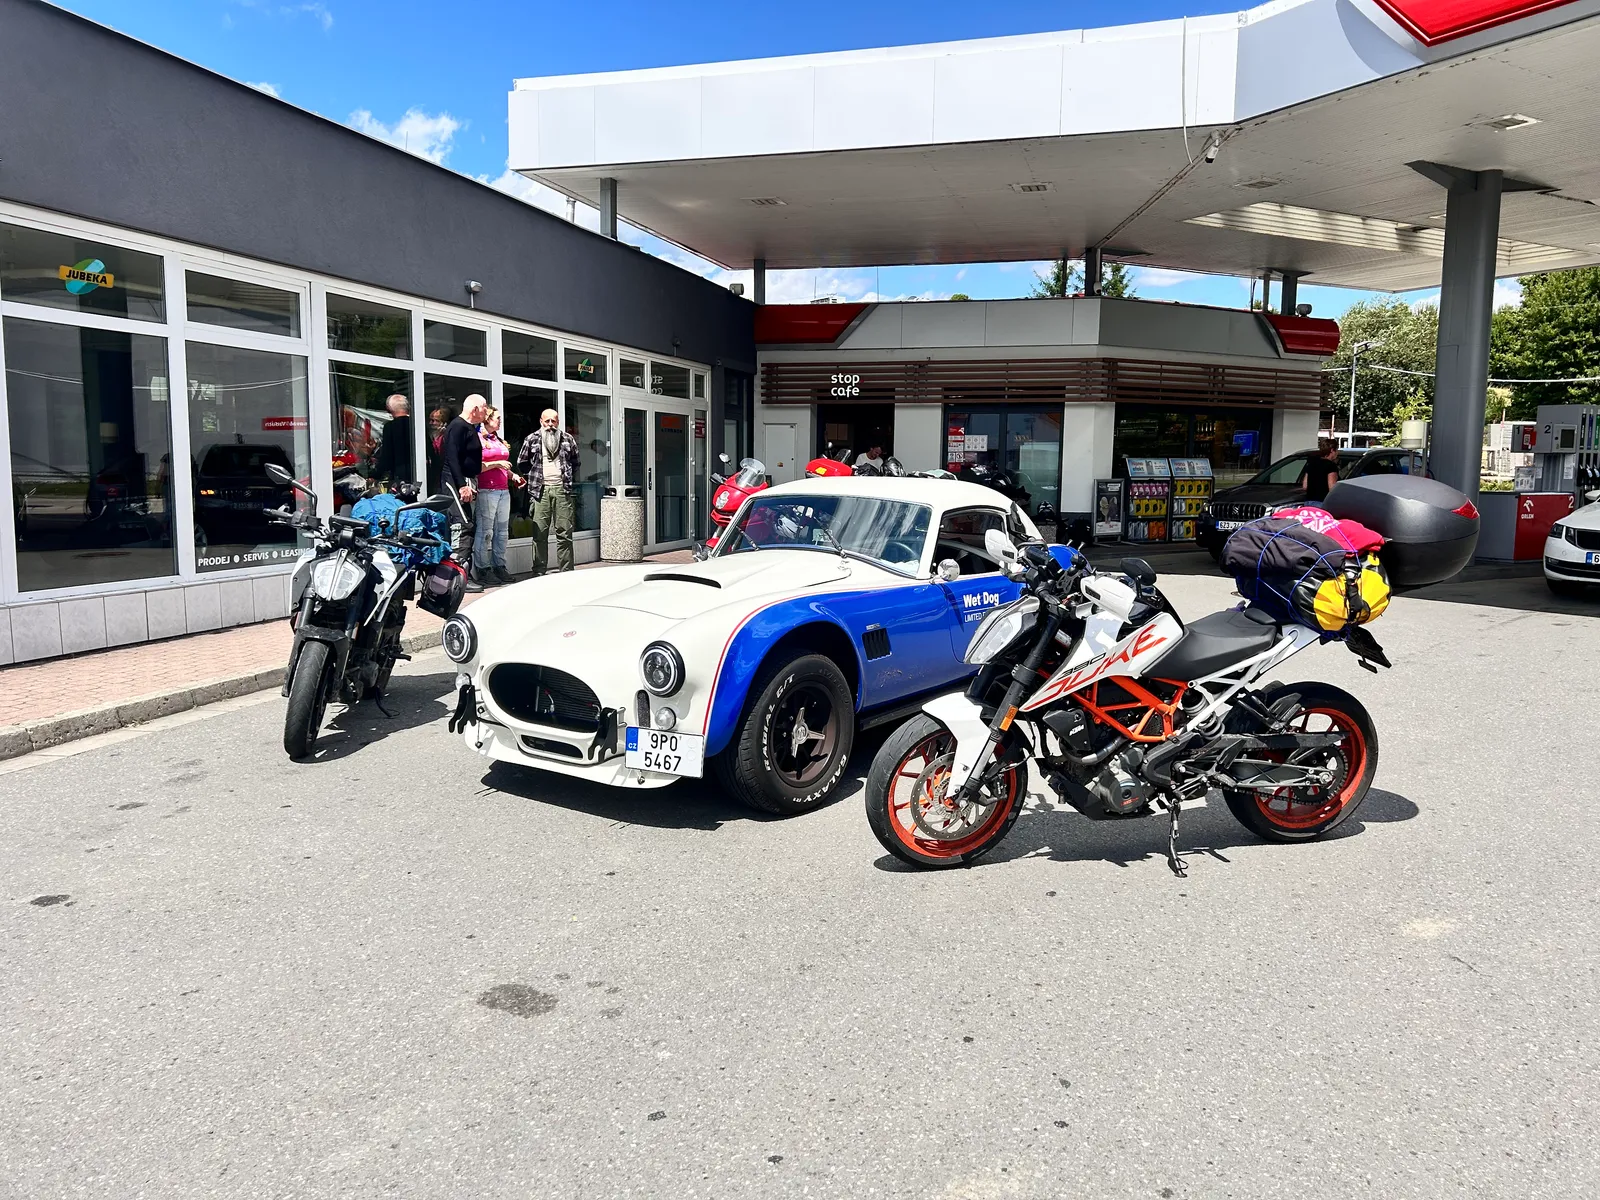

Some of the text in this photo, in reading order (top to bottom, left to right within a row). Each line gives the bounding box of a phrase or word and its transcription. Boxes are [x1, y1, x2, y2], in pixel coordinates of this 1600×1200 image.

[66, 269, 107, 284] JUBEKA
[831, 373, 860, 386] stop
[831, 385, 860, 397] cafe
[1544, 425, 1551, 434] 2
[1568, 495, 1574, 508] 2
[198, 555, 230, 566] PRODEJ
[243, 551, 269, 562] SERVIS
[1594, 554, 1600, 563] 6
[963, 591, 999, 608] Wet Dog
[1023, 623, 1168, 711] DUKE
[762, 673, 795, 771] RADIAL G/T
[1069, 725, 1084, 736] KTM
[650, 733, 678, 751] 9P0
[644, 752, 682, 771] 5467
[804, 754, 847, 803] GALAXY
